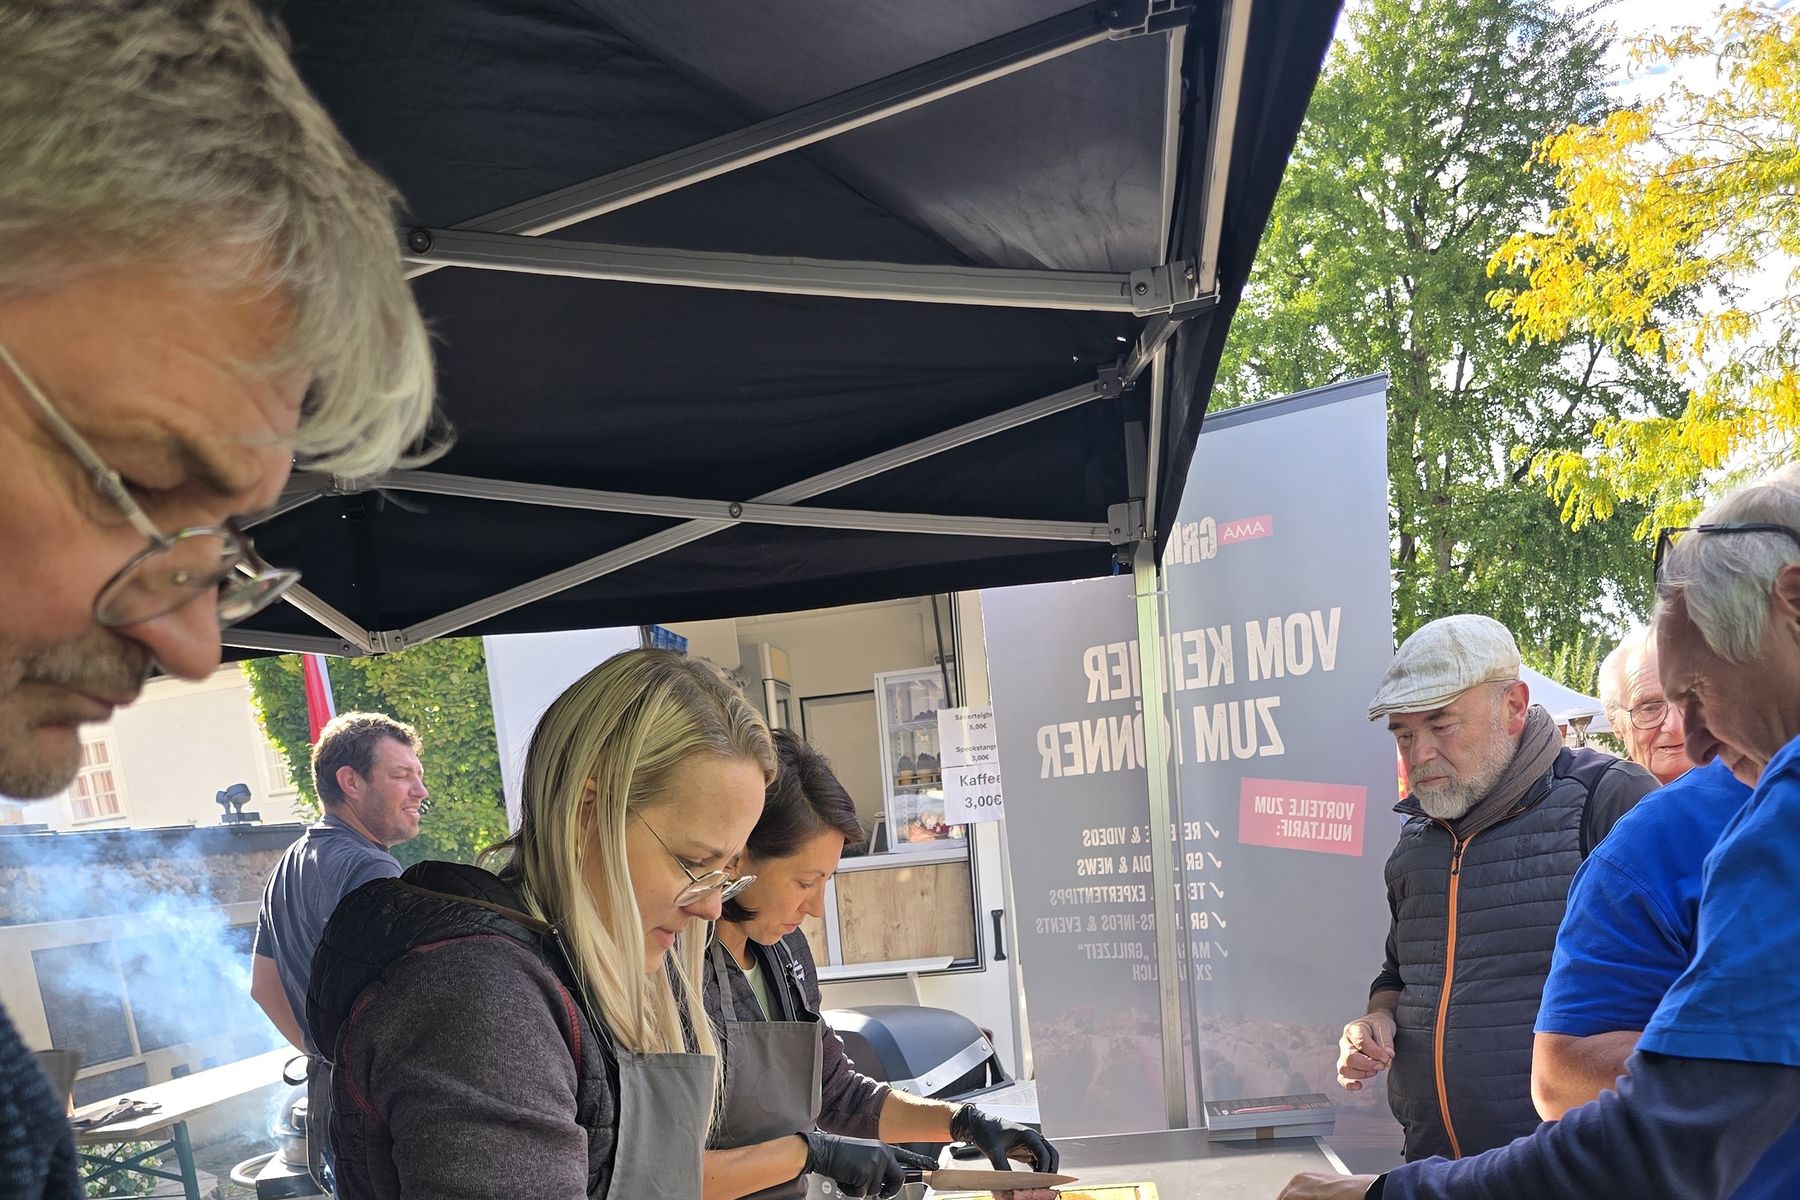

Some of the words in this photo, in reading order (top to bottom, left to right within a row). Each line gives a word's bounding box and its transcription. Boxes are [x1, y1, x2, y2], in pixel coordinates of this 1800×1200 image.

[969, 723, 987, 731] 5,00€
[971, 754, 989, 762] 3,00€
[964, 794, 1002, 810] 3,00€
